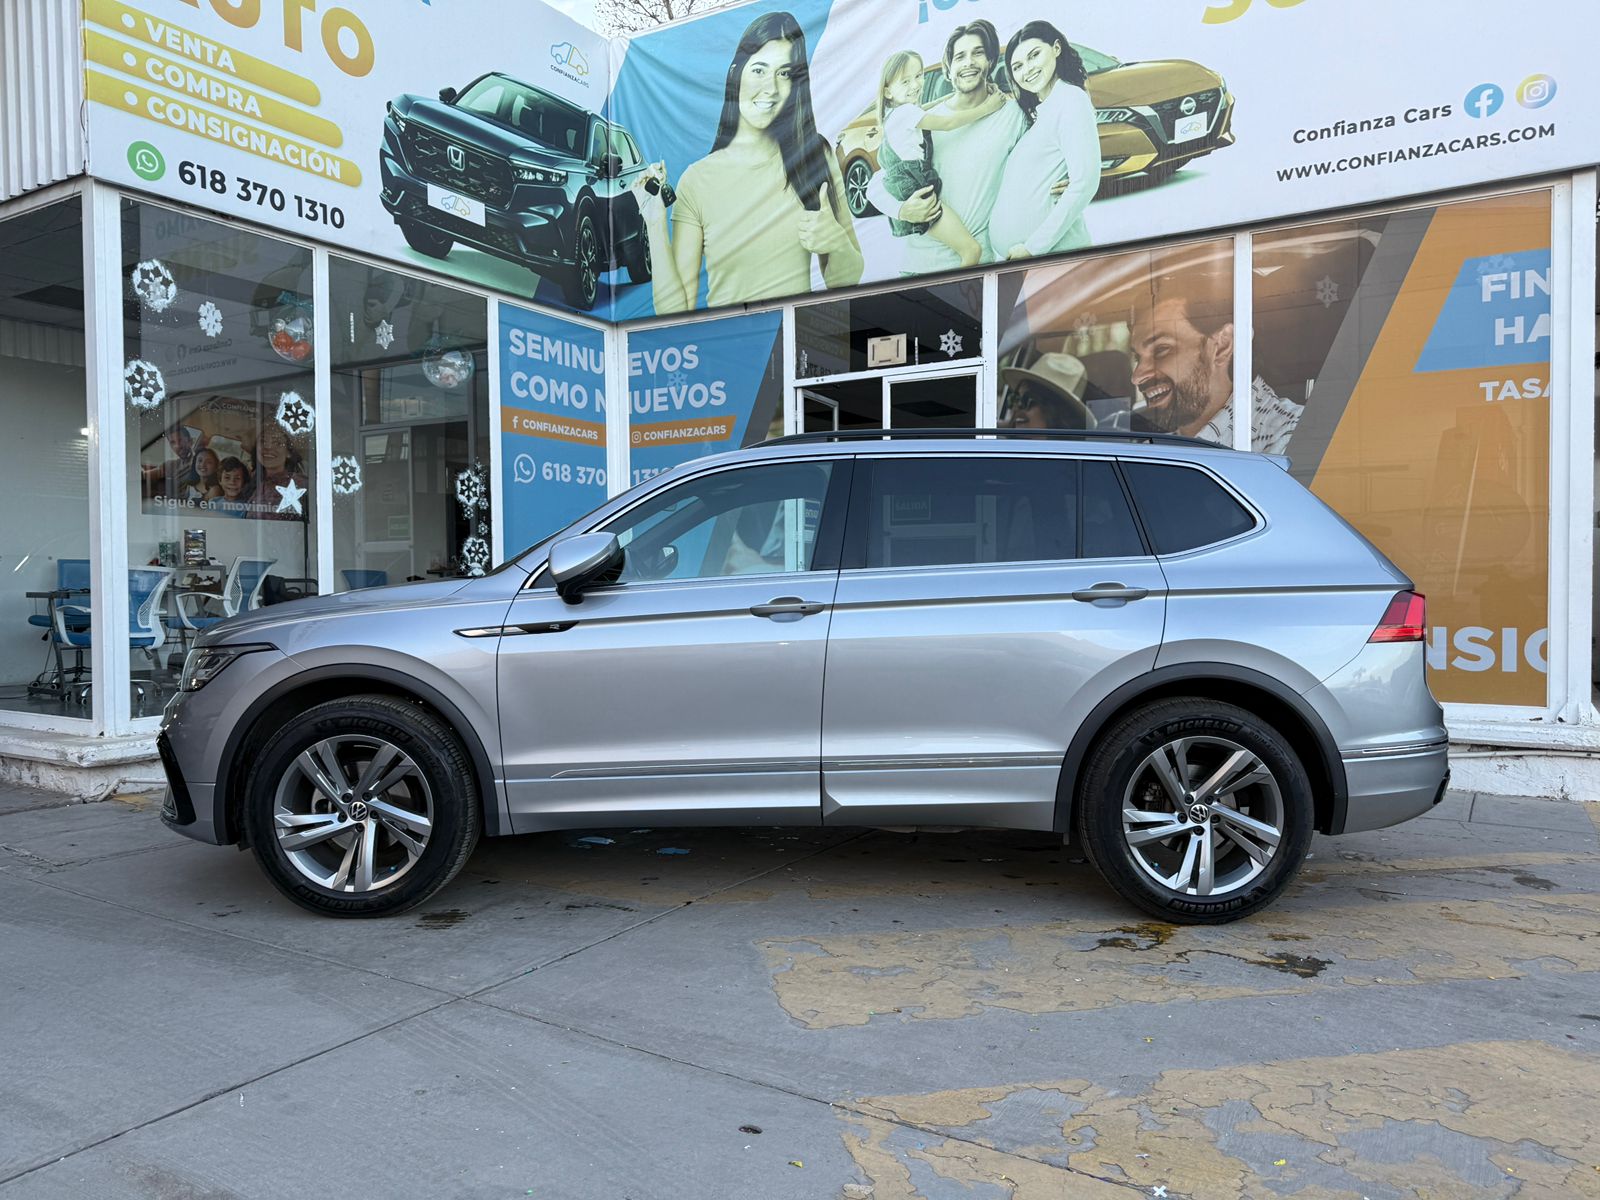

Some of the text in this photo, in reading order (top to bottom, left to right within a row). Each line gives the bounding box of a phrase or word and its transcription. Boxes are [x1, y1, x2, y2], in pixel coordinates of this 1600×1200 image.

[144, 17, 236, 72] VENTA
[176, 0, 375, 78] TO
[145, 57, 263, 118] COMPRA
[146, 95, 341, 180] CONSIGNACIÓN
[1292, 103, 1452, 145] Confianza Cars
[1276, 122, 1556, 182] WWW.CONFIANZACARS.COM
[178, 160, 345, 230] 618 370 1310
[1481, 268, 1552, 303] FIN
[510, 370, 588, 410] COMO
[522, 419, 599, 441] CONFIANZACARS
[643, 424, 727, 441] CONFIANZACARS
[541, 461, 673, 486] 618 370 13
[154, 495, 195, 511] Sigue
[200, 500, 217, 510] en
